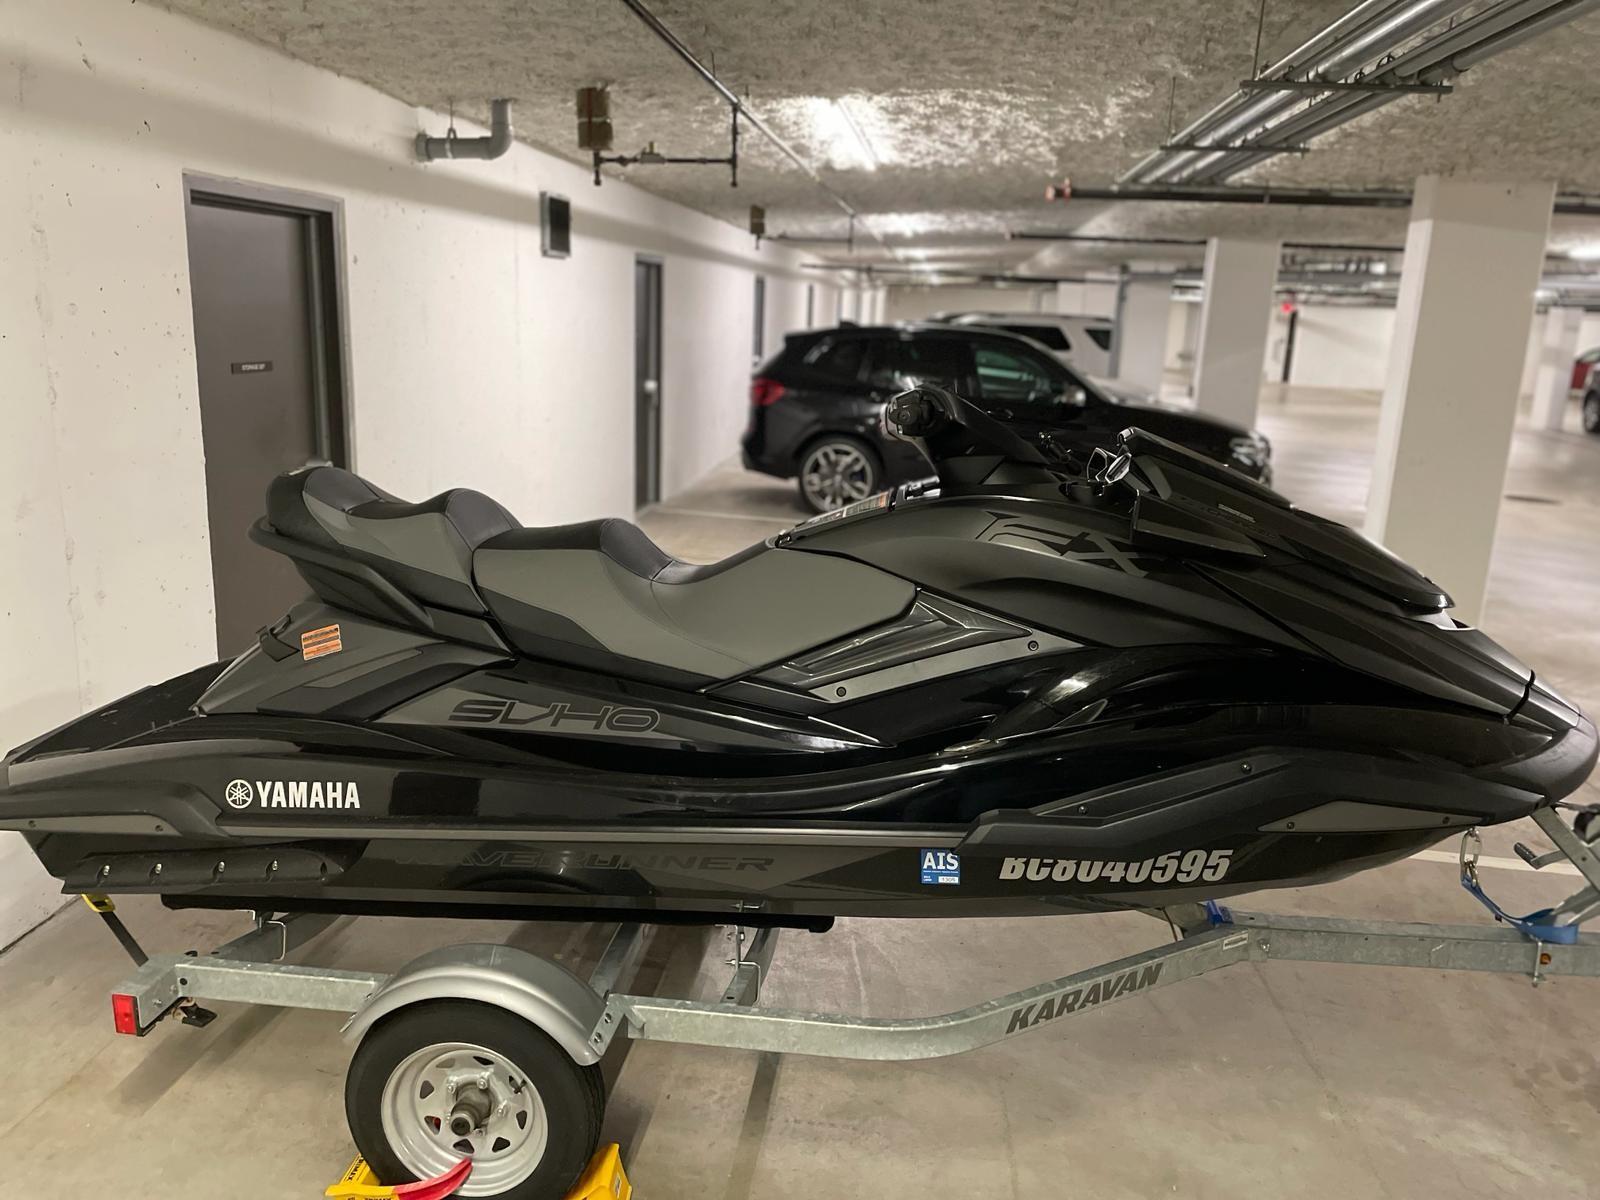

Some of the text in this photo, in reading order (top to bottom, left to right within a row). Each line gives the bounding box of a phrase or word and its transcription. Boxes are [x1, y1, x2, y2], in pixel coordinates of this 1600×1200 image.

[448, 699, 661, 732] SVHO
[255, 781, 361, 809] YAMAHA
[922, 852, 959, 871] AIS
[999, 849, 1234, 883] BC8040595
[1005, 962, 1164, 1035] KARAVAN
